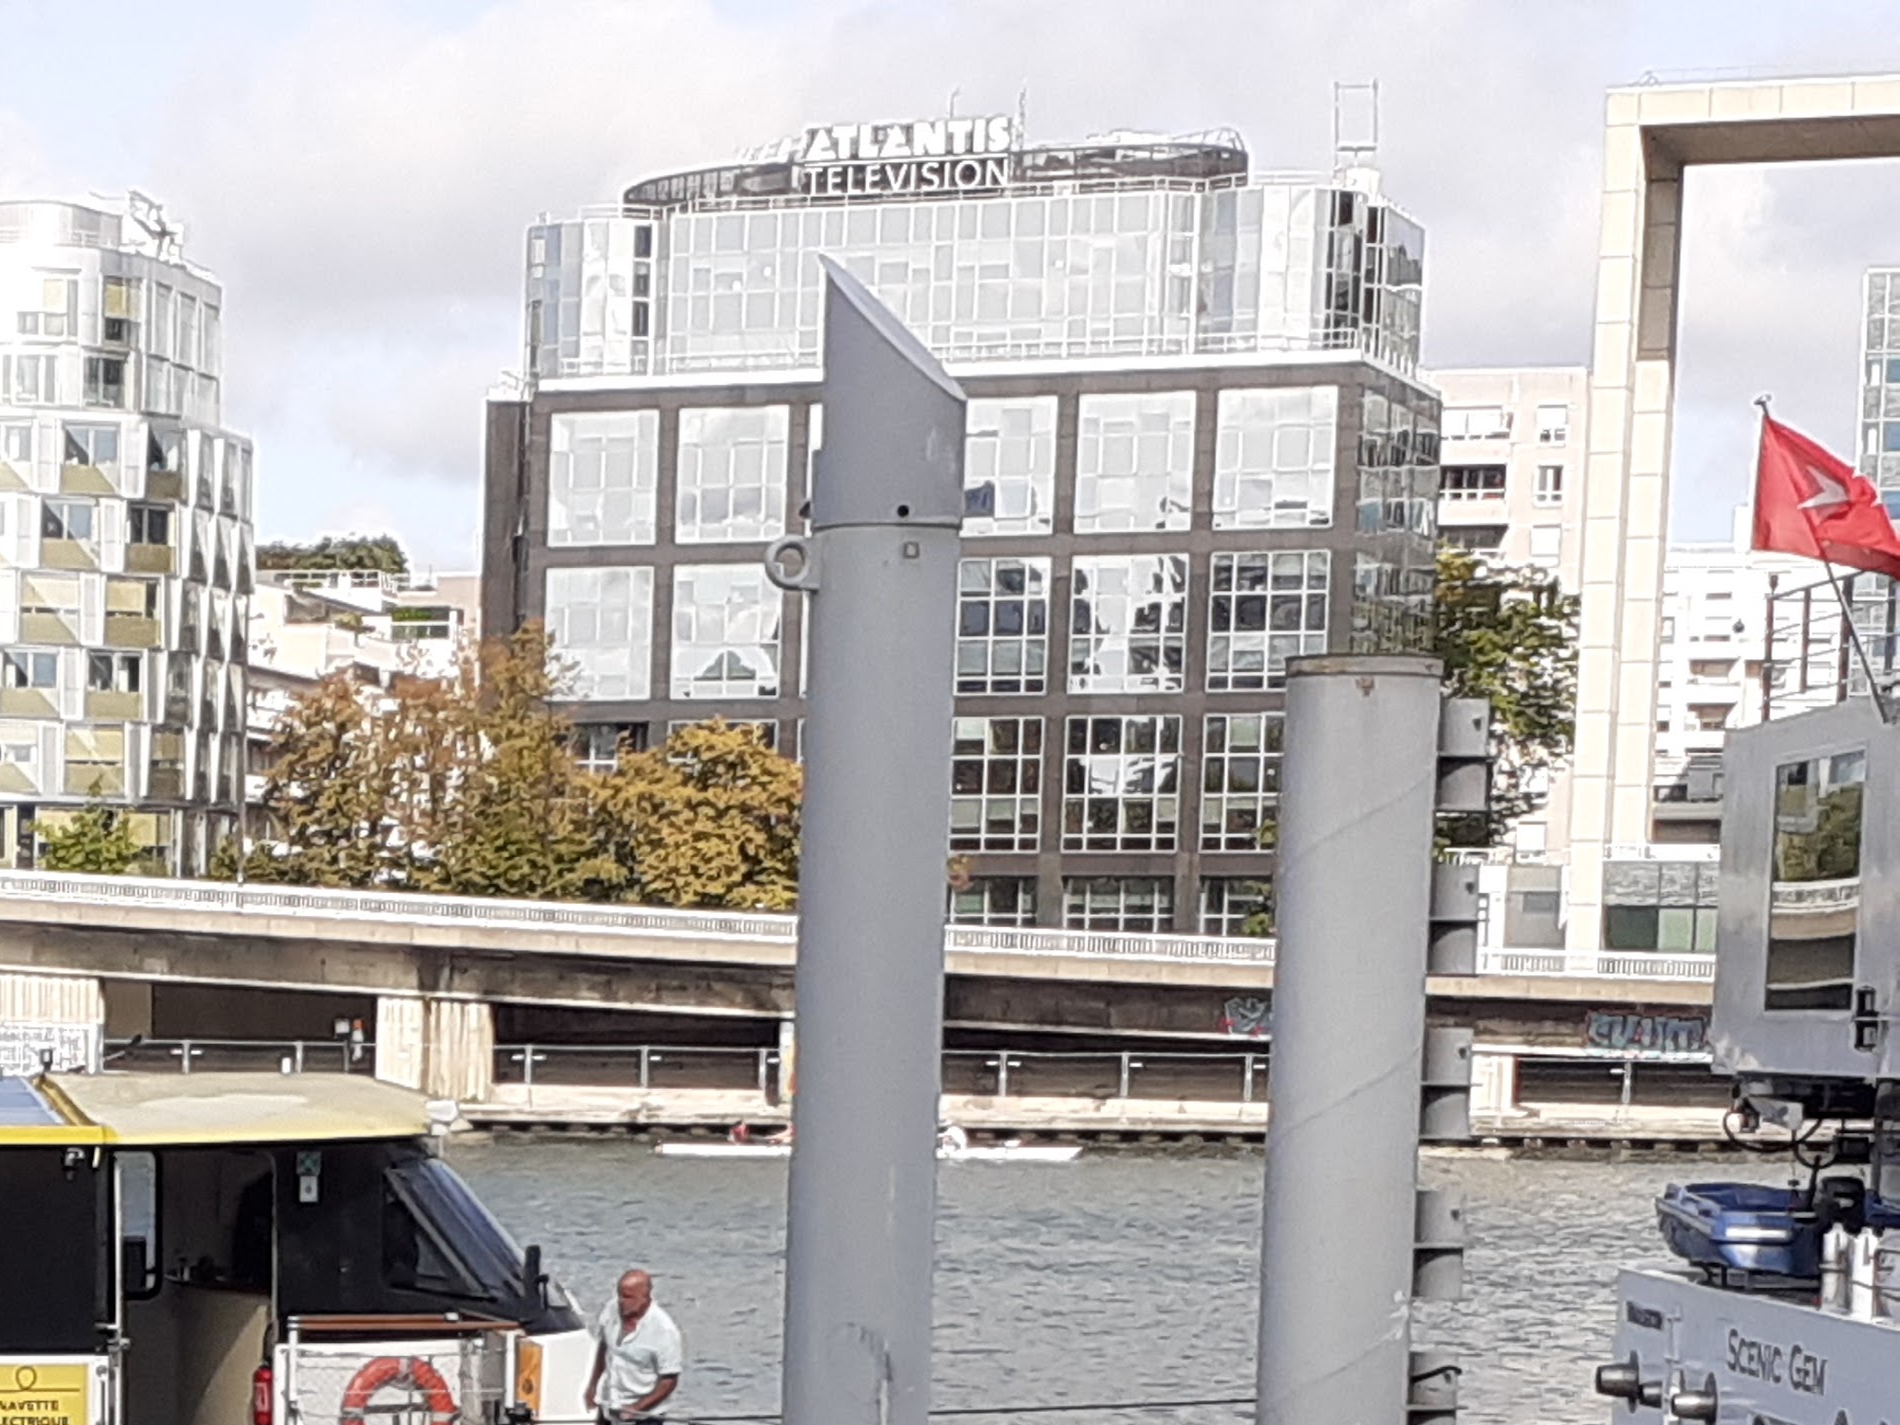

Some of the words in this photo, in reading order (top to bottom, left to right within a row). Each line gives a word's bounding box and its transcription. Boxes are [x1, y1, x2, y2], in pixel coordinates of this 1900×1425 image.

[805, 117, 1011, 161] ATLANTIS
[806, 158, 1010, 194] TELEVISION
[1727, 1328, 1781, 1384] SCENIC
[1789, 1344, 1828, 1395] GEM
